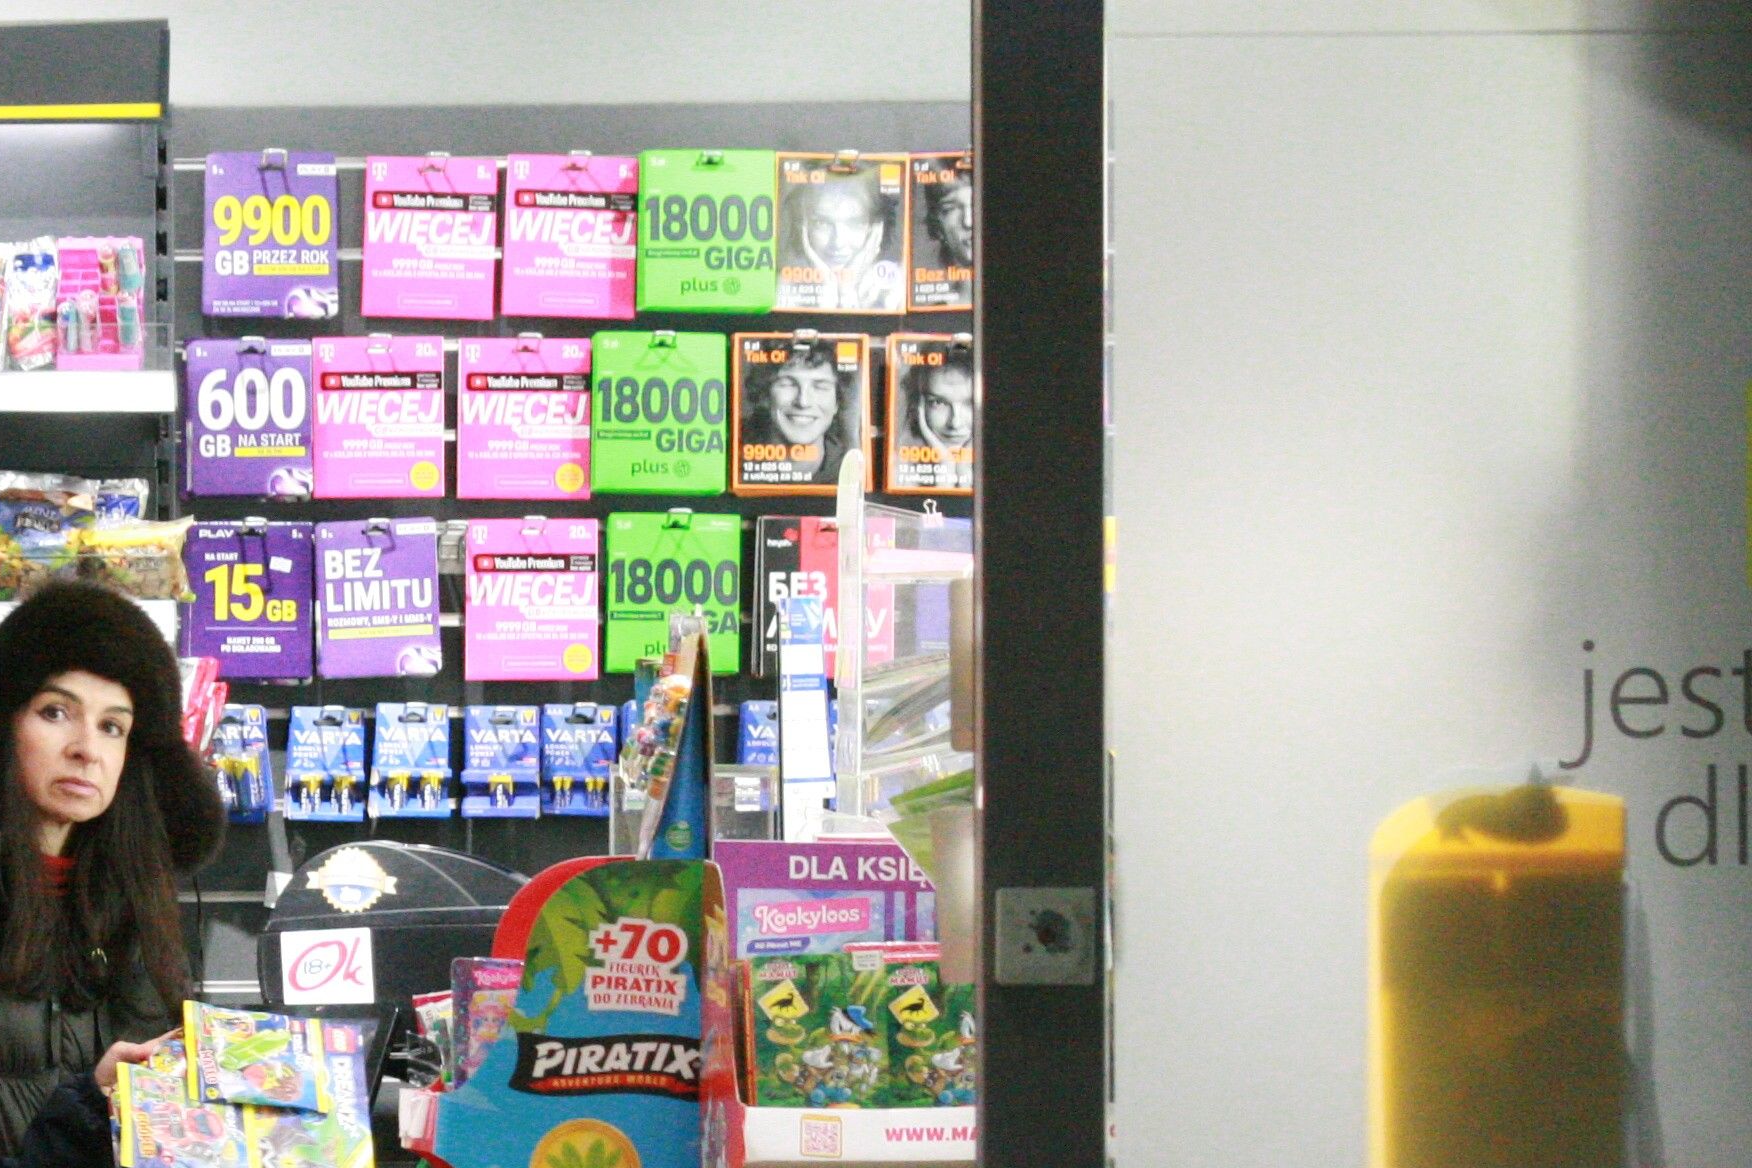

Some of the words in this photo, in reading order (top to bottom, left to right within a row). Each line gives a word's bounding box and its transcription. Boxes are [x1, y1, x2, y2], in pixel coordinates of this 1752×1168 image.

[785, 171, 808, 184] Tak
[915, 171, 937, 184] Tak
[393, 193, 426, 207] YouTube
[426, 195, 464, 209] Premium
[536, 192, 568, 207] YouTube
[568, 194, 606, 207] Premium
[213, 194, 332, 246] 9900
[645, 194, 774, 242] 18000
[367, 210, 494, 248] WIĘCEJ
[508, 209, 636, 246] WIĘCEJ
[215, 250, 250, 276] GB
[253, 250, 297, 264] PRZEZ
[300, 250, 330, 264] ROK
[704, 246, 774, 271] GIGA
[915, 267, 945, 283] Bez
[680, 278, 719, 296] plus
[745, 350, 767, 363] Tak
[902, 353, 925, 365] Tak
[341, 375, 374, 387] YouTube
[374, 375, 412, 388] Premium
[487, 375, 520, 388] YouTube
[520, 376, 558, 389] Premium
[198, 367, 306, 431] 600
[597, 376, 725, 425] 18000
[316, 392, 441, 430] WIĘCEJ
[461, 393, 588, 430] WIĘCEJ
[199, 434, 232, 458] GB
[238, 434, 257, 447] NA
[260, 433, 302, 447] START
[656, 428, 725, 454] GIGA
[743, 444, 787, 461] 9900
[790, 444, 819, 461] GB
[899, 446, 940, 462] 9900
[631, 459, 669, 477] plus
[198, 528, 235, 539] PLAY
[324, 547, 383, 579] BEZ
[494, 556, 527, 570] YouTube
[527, 556, 566, 570] Premium
[610, 558, 739, 606] 18000
[204, 562, 265, 622] 15
[266, 599, 298, 623] GB
[325, 577, 433, 612] LIMITU
[469, 573, 595, 612] WIĘCEJ
[293, 730, 362, 745] VARTA
[378, 726, 446, 743] VARTA
[469, 728, 537, 744] VARTA
[545, 727, 613, 743] VARTA
[789, 856, 848, 881] DLA
[753, 904, 861, 934] Kookyloos
[595, 923, 681, 964] +70
[303, 958, 332, 974] 18+
[609, 962, 660, 977] FIGUREK
[591, 974, 678, 996] PIRATIX
[593, 993, 610, 1004] DO
[615, 993, 674, 1010] ZEBRANIA
[531, 1040, 701, 1080] PIRATIX
[626, 1075, 667, 1085] WORLD
